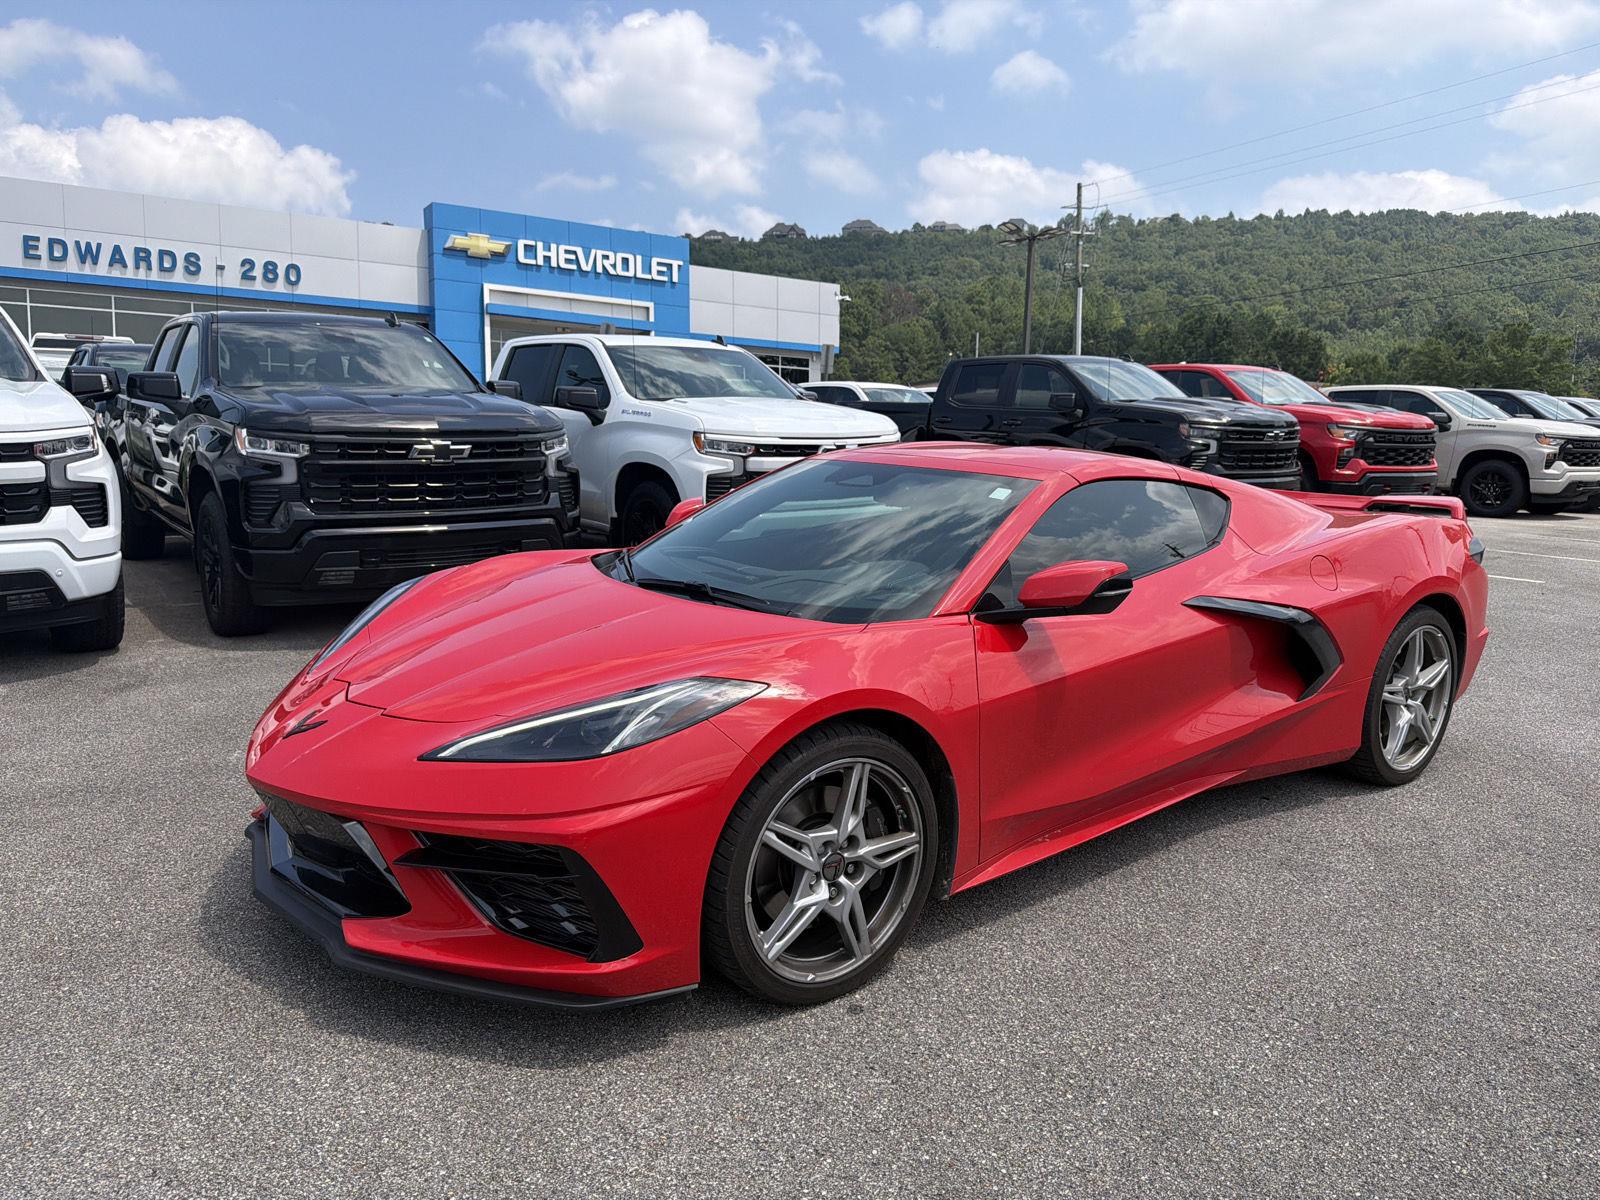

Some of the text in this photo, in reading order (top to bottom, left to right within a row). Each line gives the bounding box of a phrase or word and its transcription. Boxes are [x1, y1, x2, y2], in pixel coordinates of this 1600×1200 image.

[22, 234, 202, 276] EDWARDS
[240, 258, 302, 286] 280
[517, 239, 683, 283] CHEVROLET
